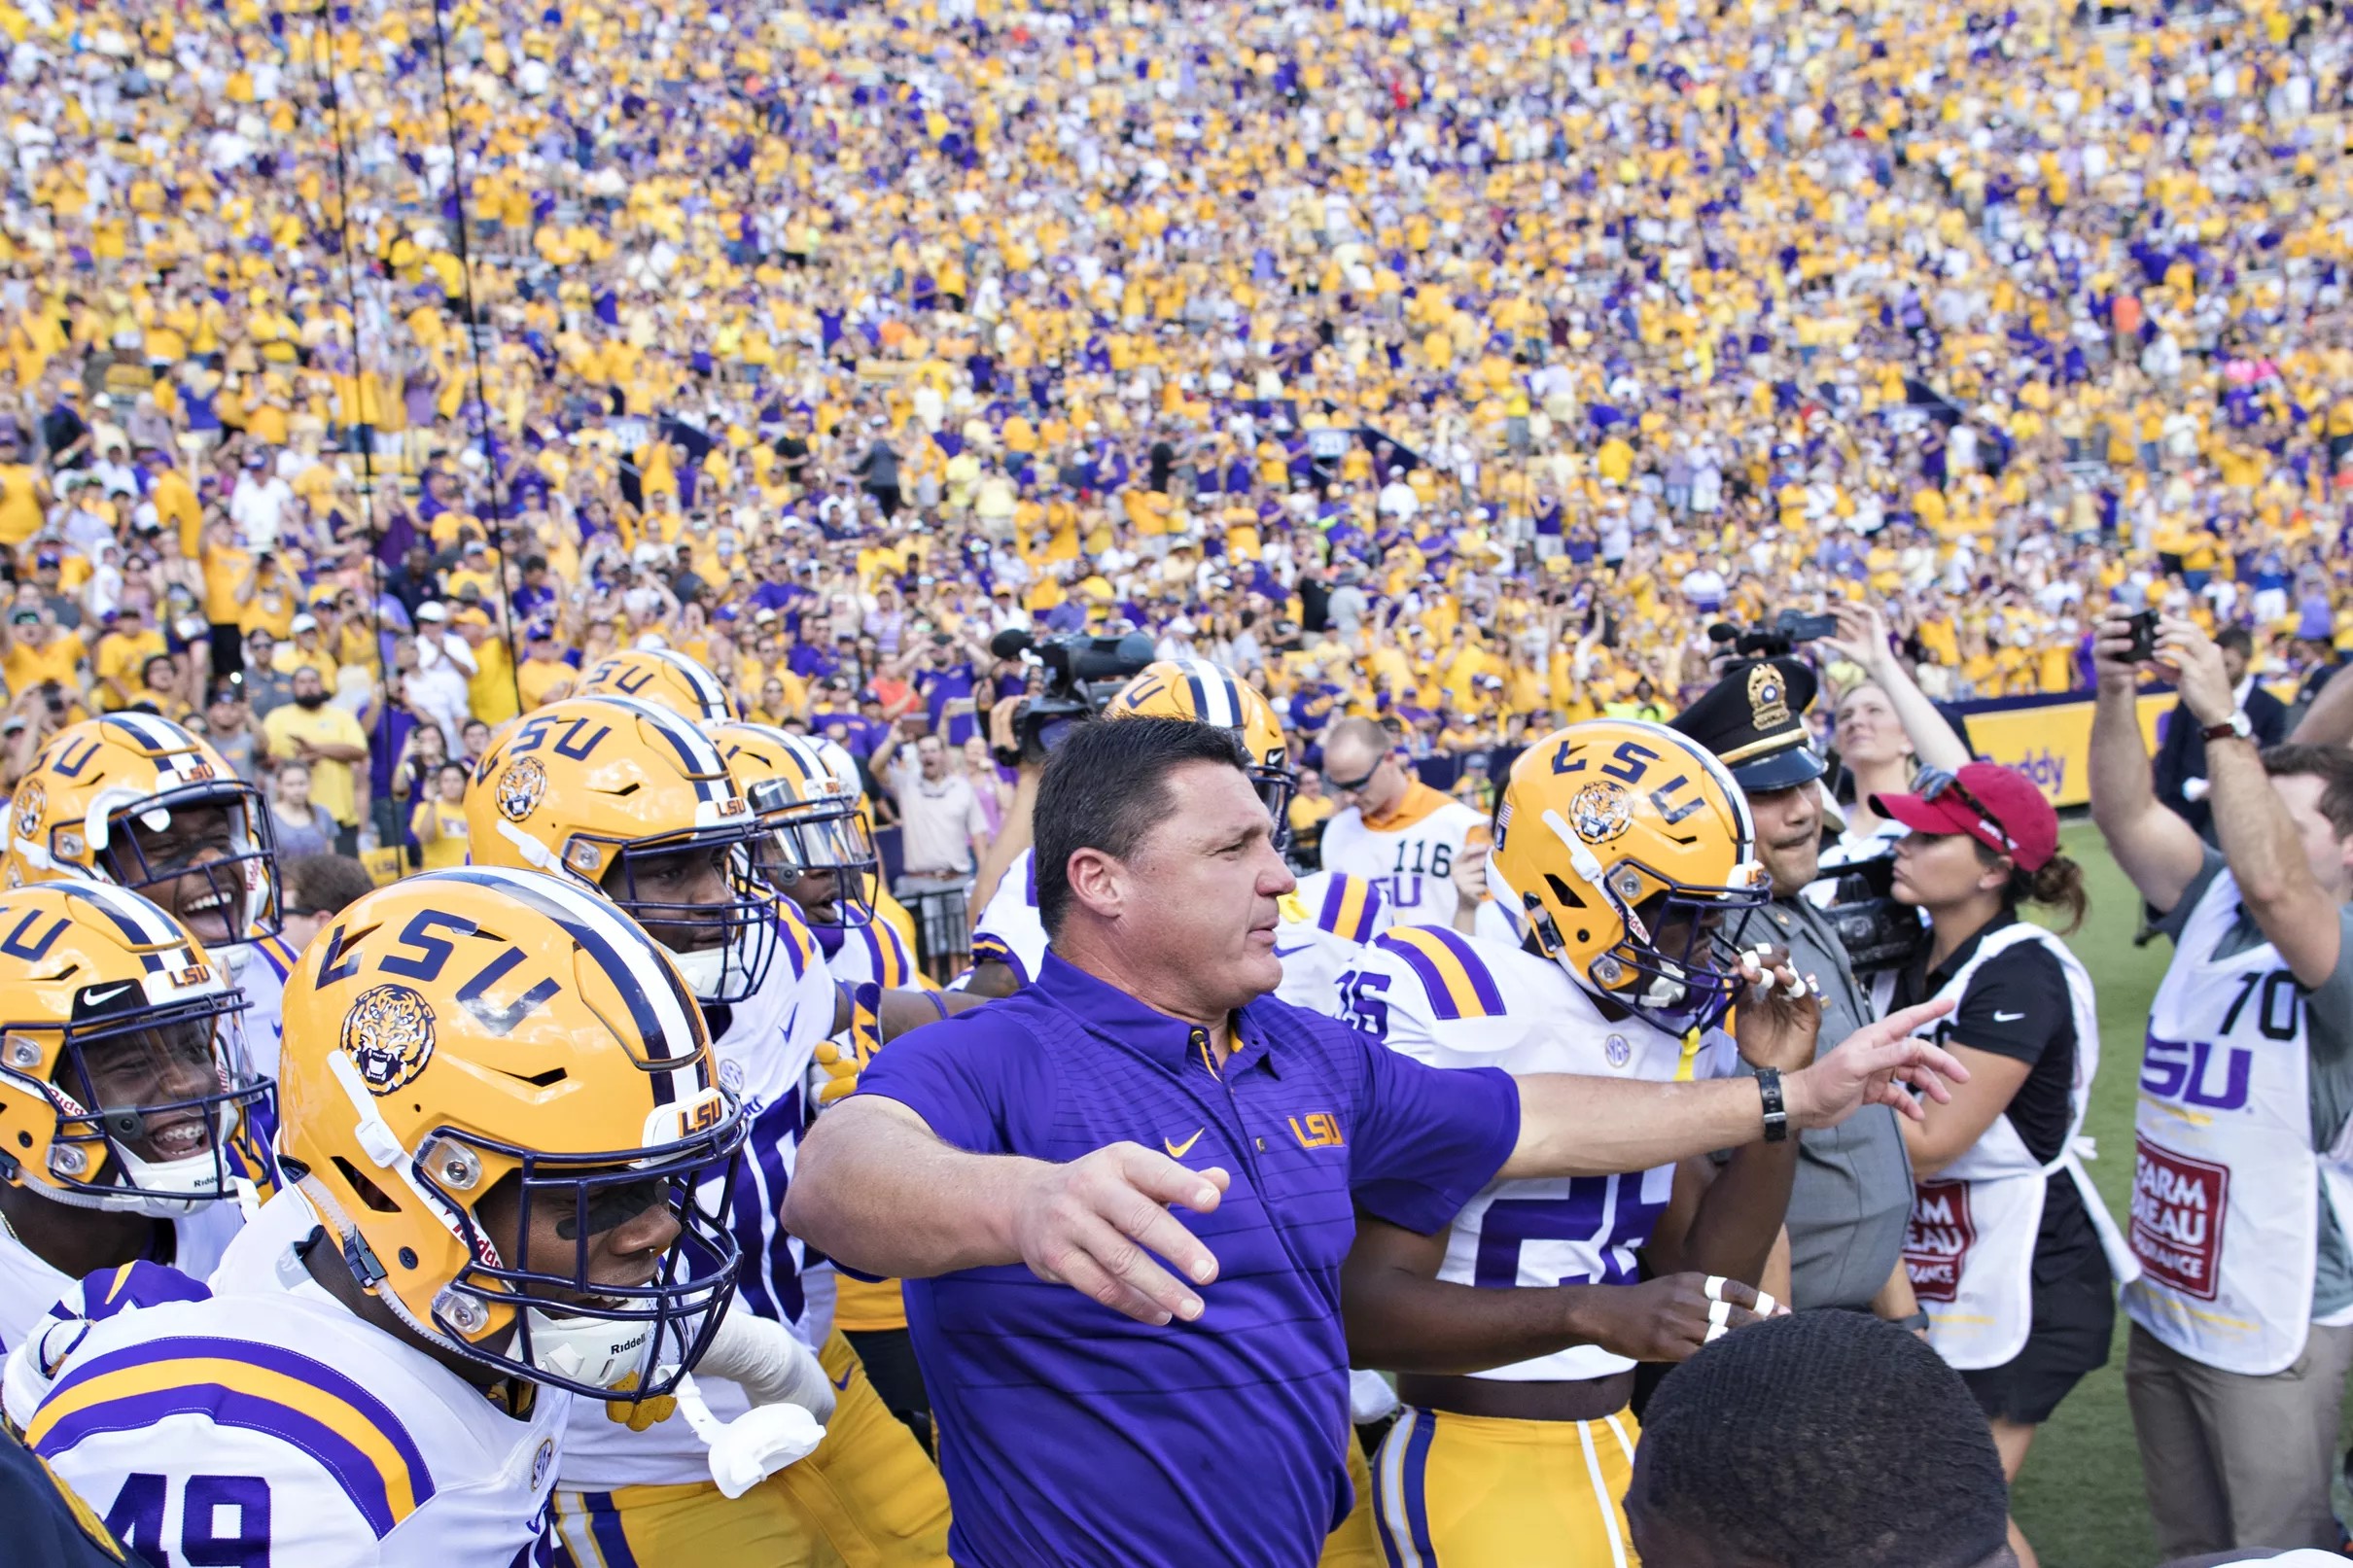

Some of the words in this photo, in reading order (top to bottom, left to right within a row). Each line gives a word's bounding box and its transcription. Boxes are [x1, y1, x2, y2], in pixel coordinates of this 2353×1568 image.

[475, 715, 613, 787] LSU
[177, 763, 216, 783] LSU
[1552, 741, 1705, 825] LSU
[716, 799, 746, 819] LSU
[1393, 840, 1452, 879] 116
[166, 964, 210, 990] LSU
[315, 909, 562, 1037] LSU
[678, 1097, 722, 1138] LSU
[1287, 1111, 1347, 1150] LSU
[611, 1333, 647, 1355] Riddell
